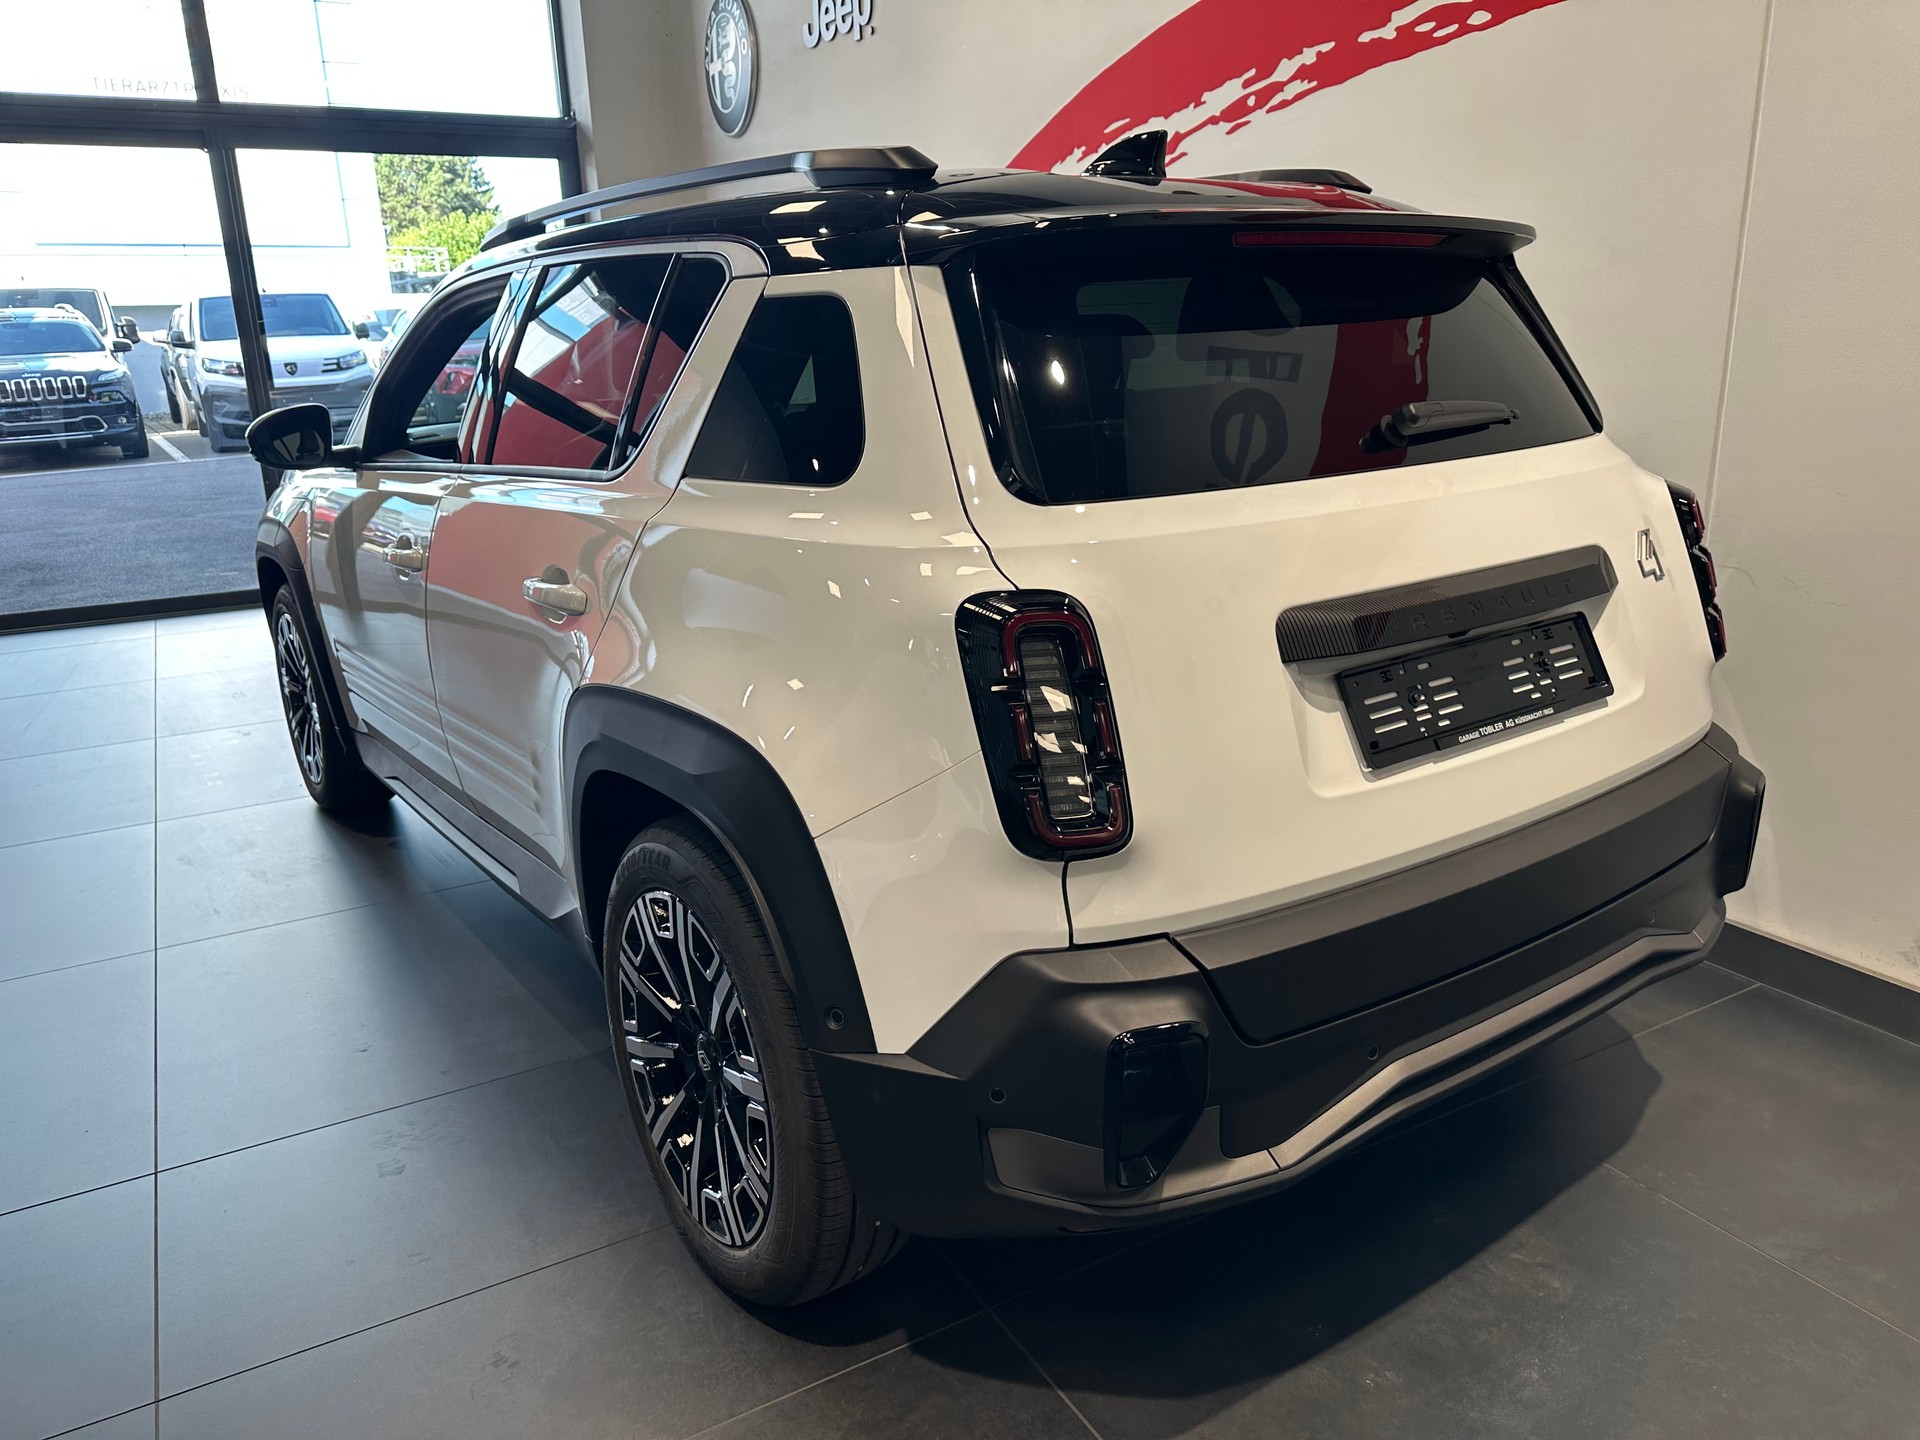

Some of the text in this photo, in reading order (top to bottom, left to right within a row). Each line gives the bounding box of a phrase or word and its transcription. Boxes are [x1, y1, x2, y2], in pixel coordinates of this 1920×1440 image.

[719, 0, 748, 55] ROMEO
[802, 0, 872, 49] Jeep
[92, 76, 249, 99] TIERARZTPXIS
[1412, 579, 1572, 631] RENAULT
[1458, 731, 1480, 743] GARAGE
[1479, 722, 1505, 736] TOBLER
[1505, 718, 1516, 728] AG
